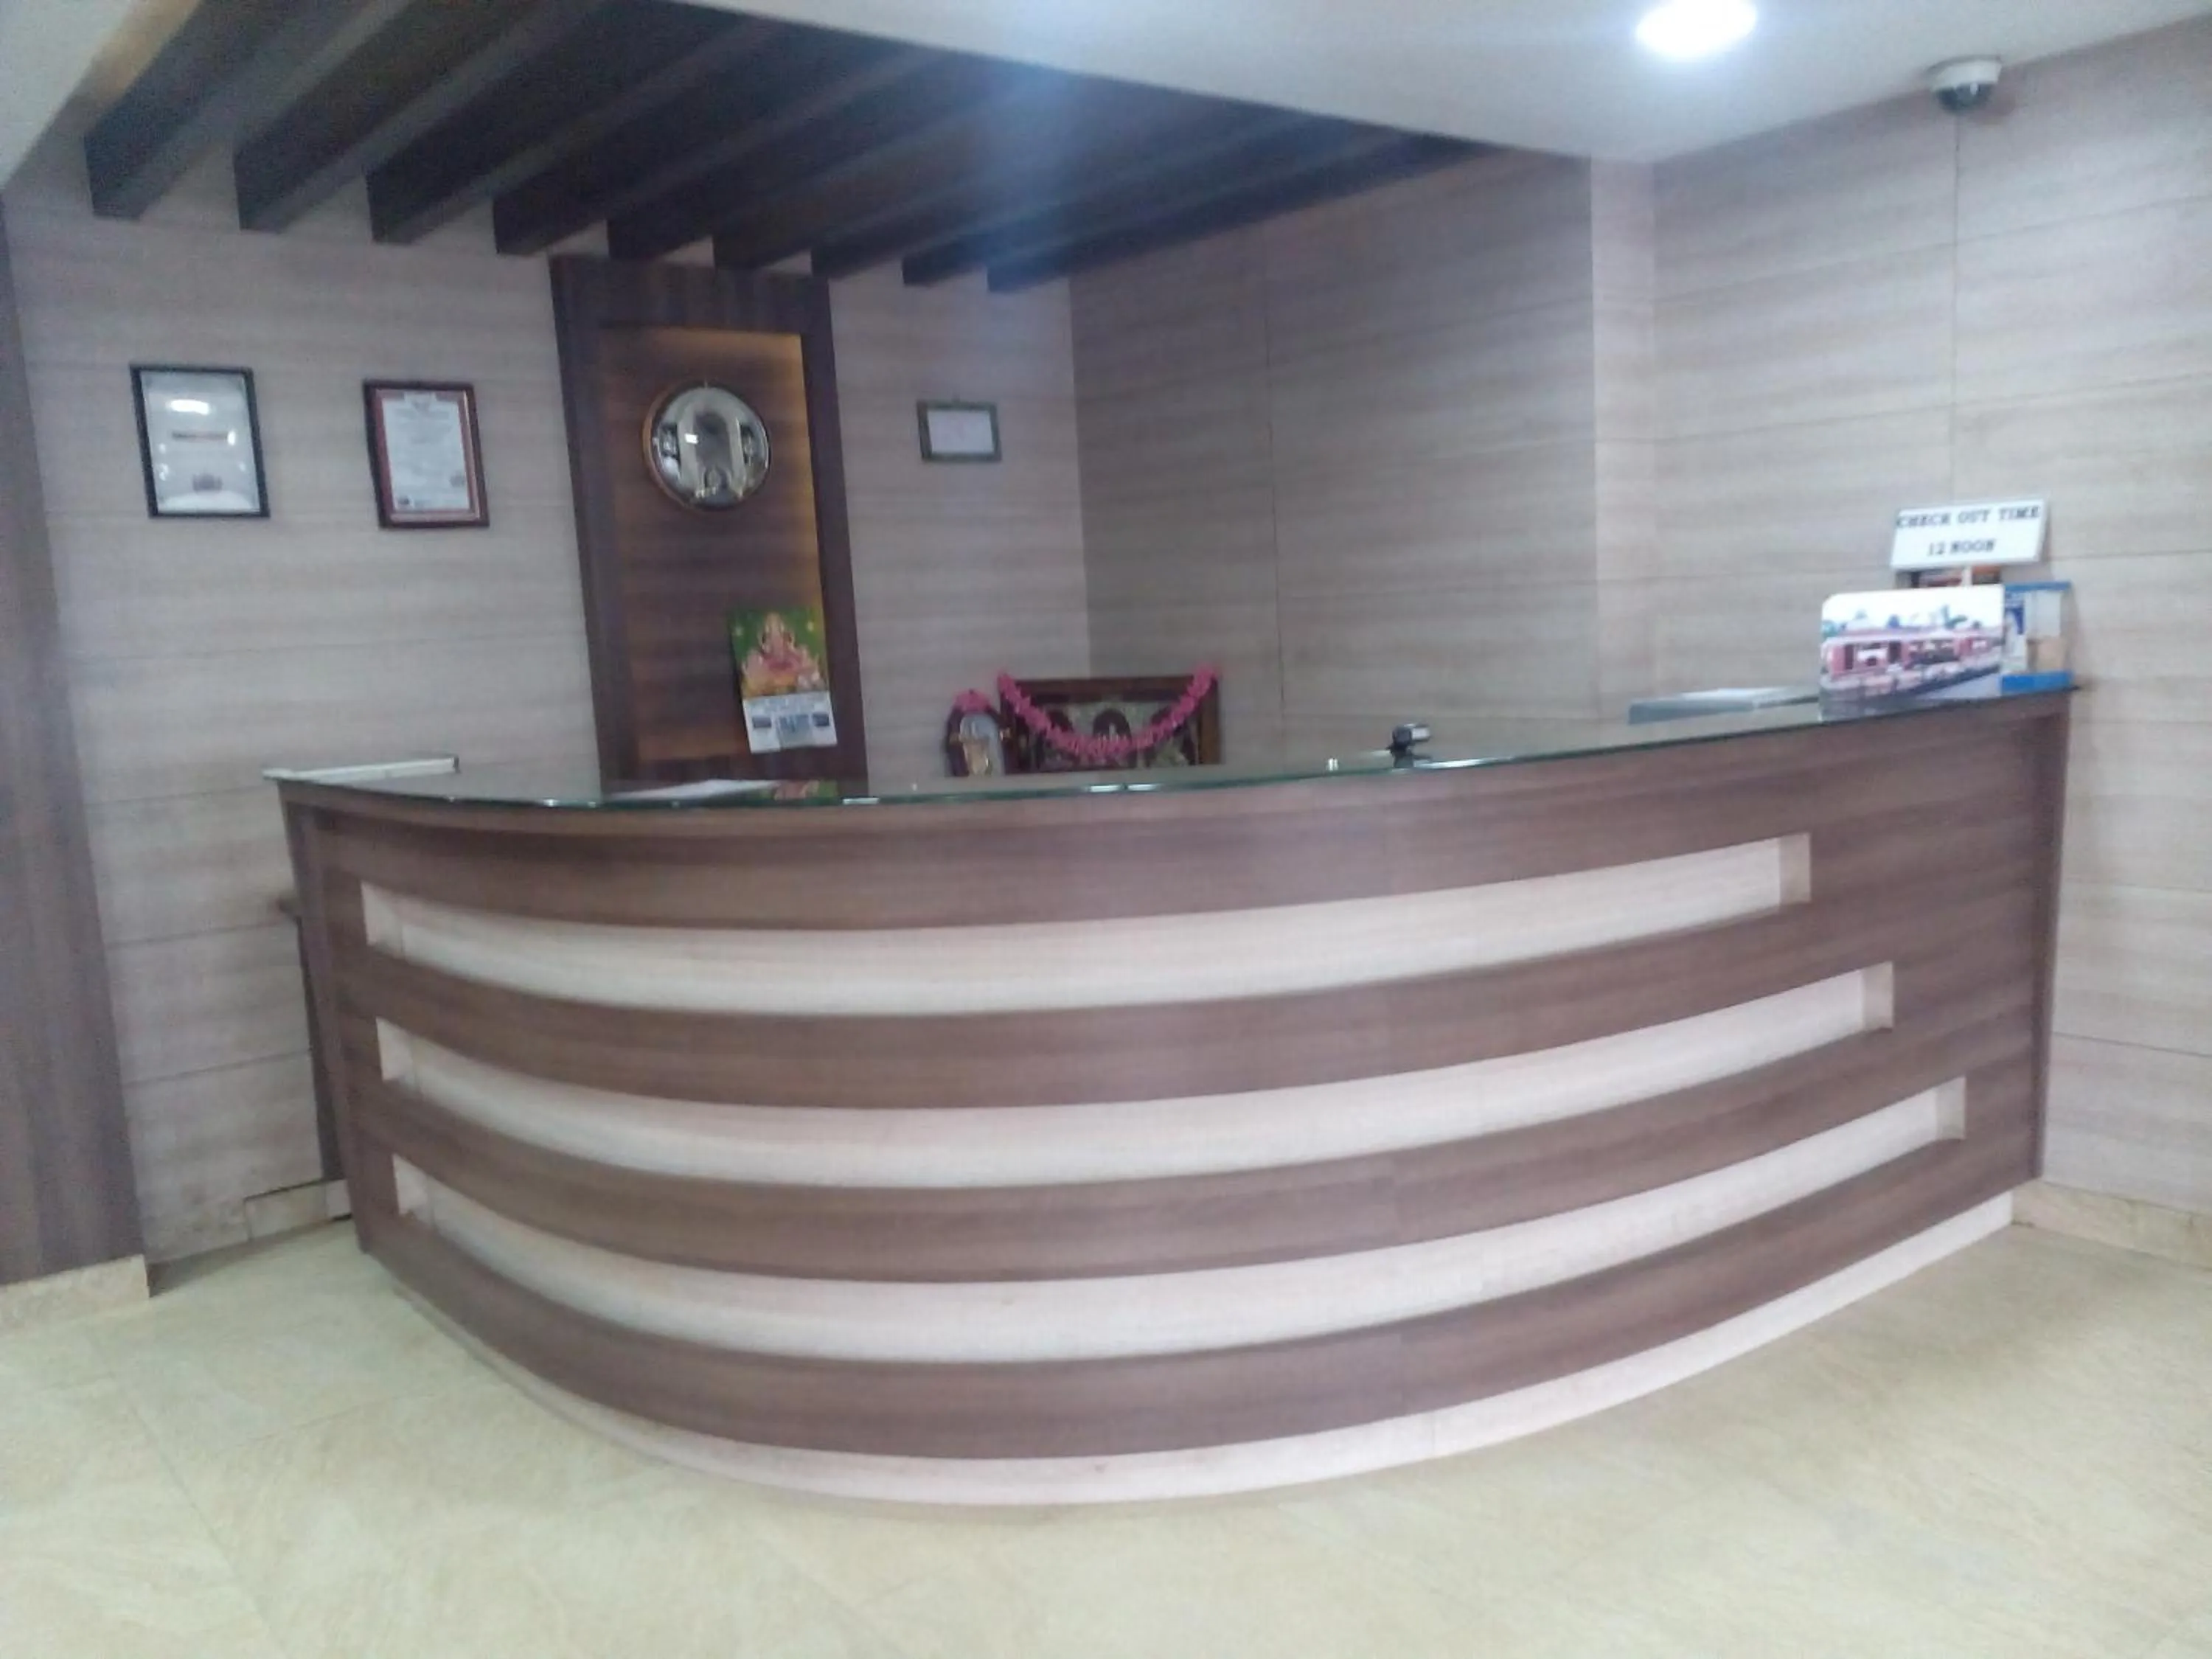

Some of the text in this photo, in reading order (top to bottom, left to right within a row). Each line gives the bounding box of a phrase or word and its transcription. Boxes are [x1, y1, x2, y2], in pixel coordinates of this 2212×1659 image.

[1896, 505, 2040, 528] CHECK OUT TIME
[1928, 539, 1995, 556] 12 NOON
